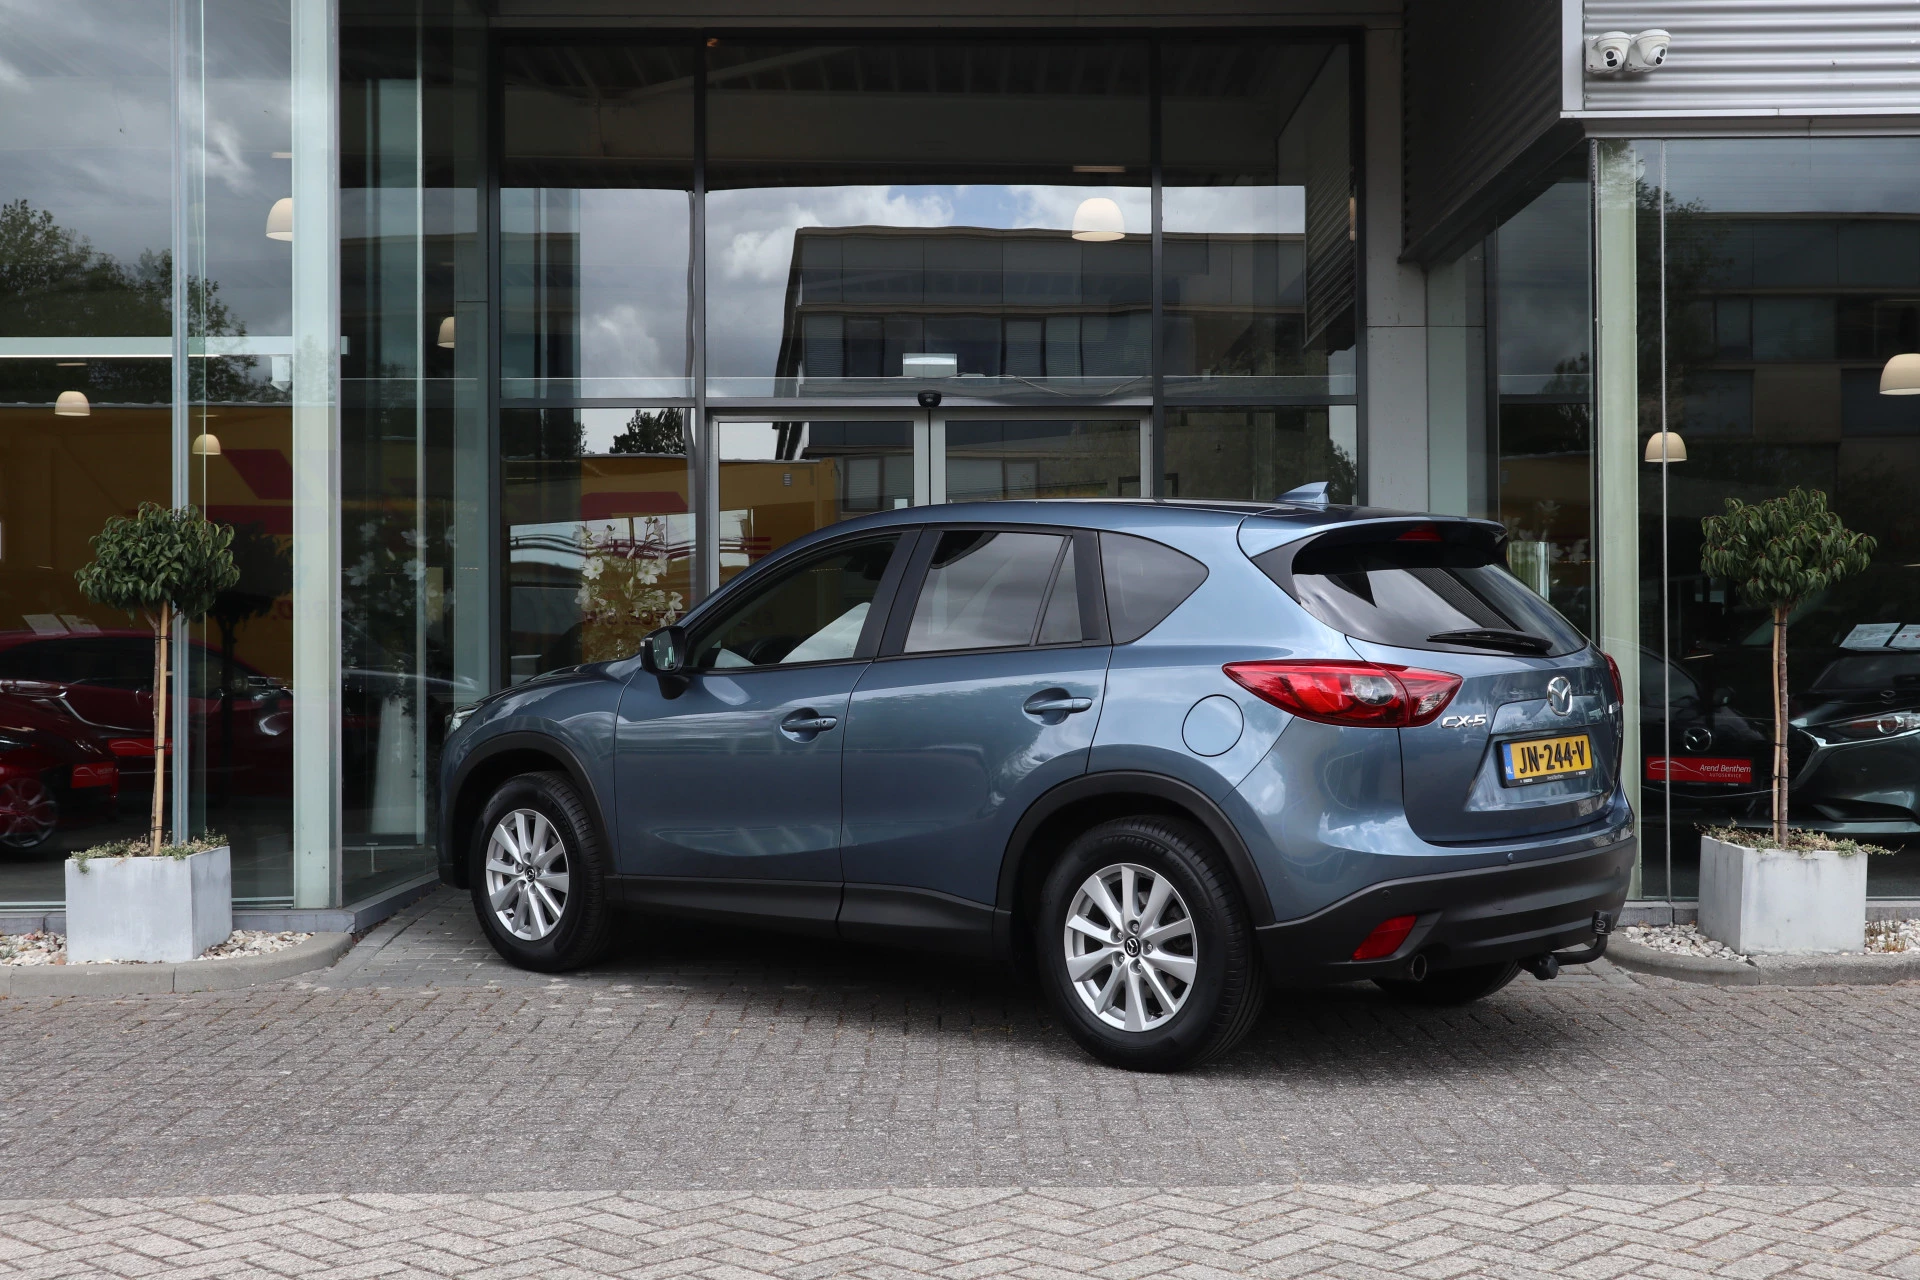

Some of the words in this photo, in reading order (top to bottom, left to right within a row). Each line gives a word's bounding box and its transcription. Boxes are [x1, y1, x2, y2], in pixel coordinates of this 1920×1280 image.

[1441, 714, 1487, 728] CX-5
[1519, 740, 1585, 774] JN-244-V
[1505, 766, 1513, 774] NL
[1699, 763, 1719, 772] Arend
[1720, 764, 1752, 773] Benthem
